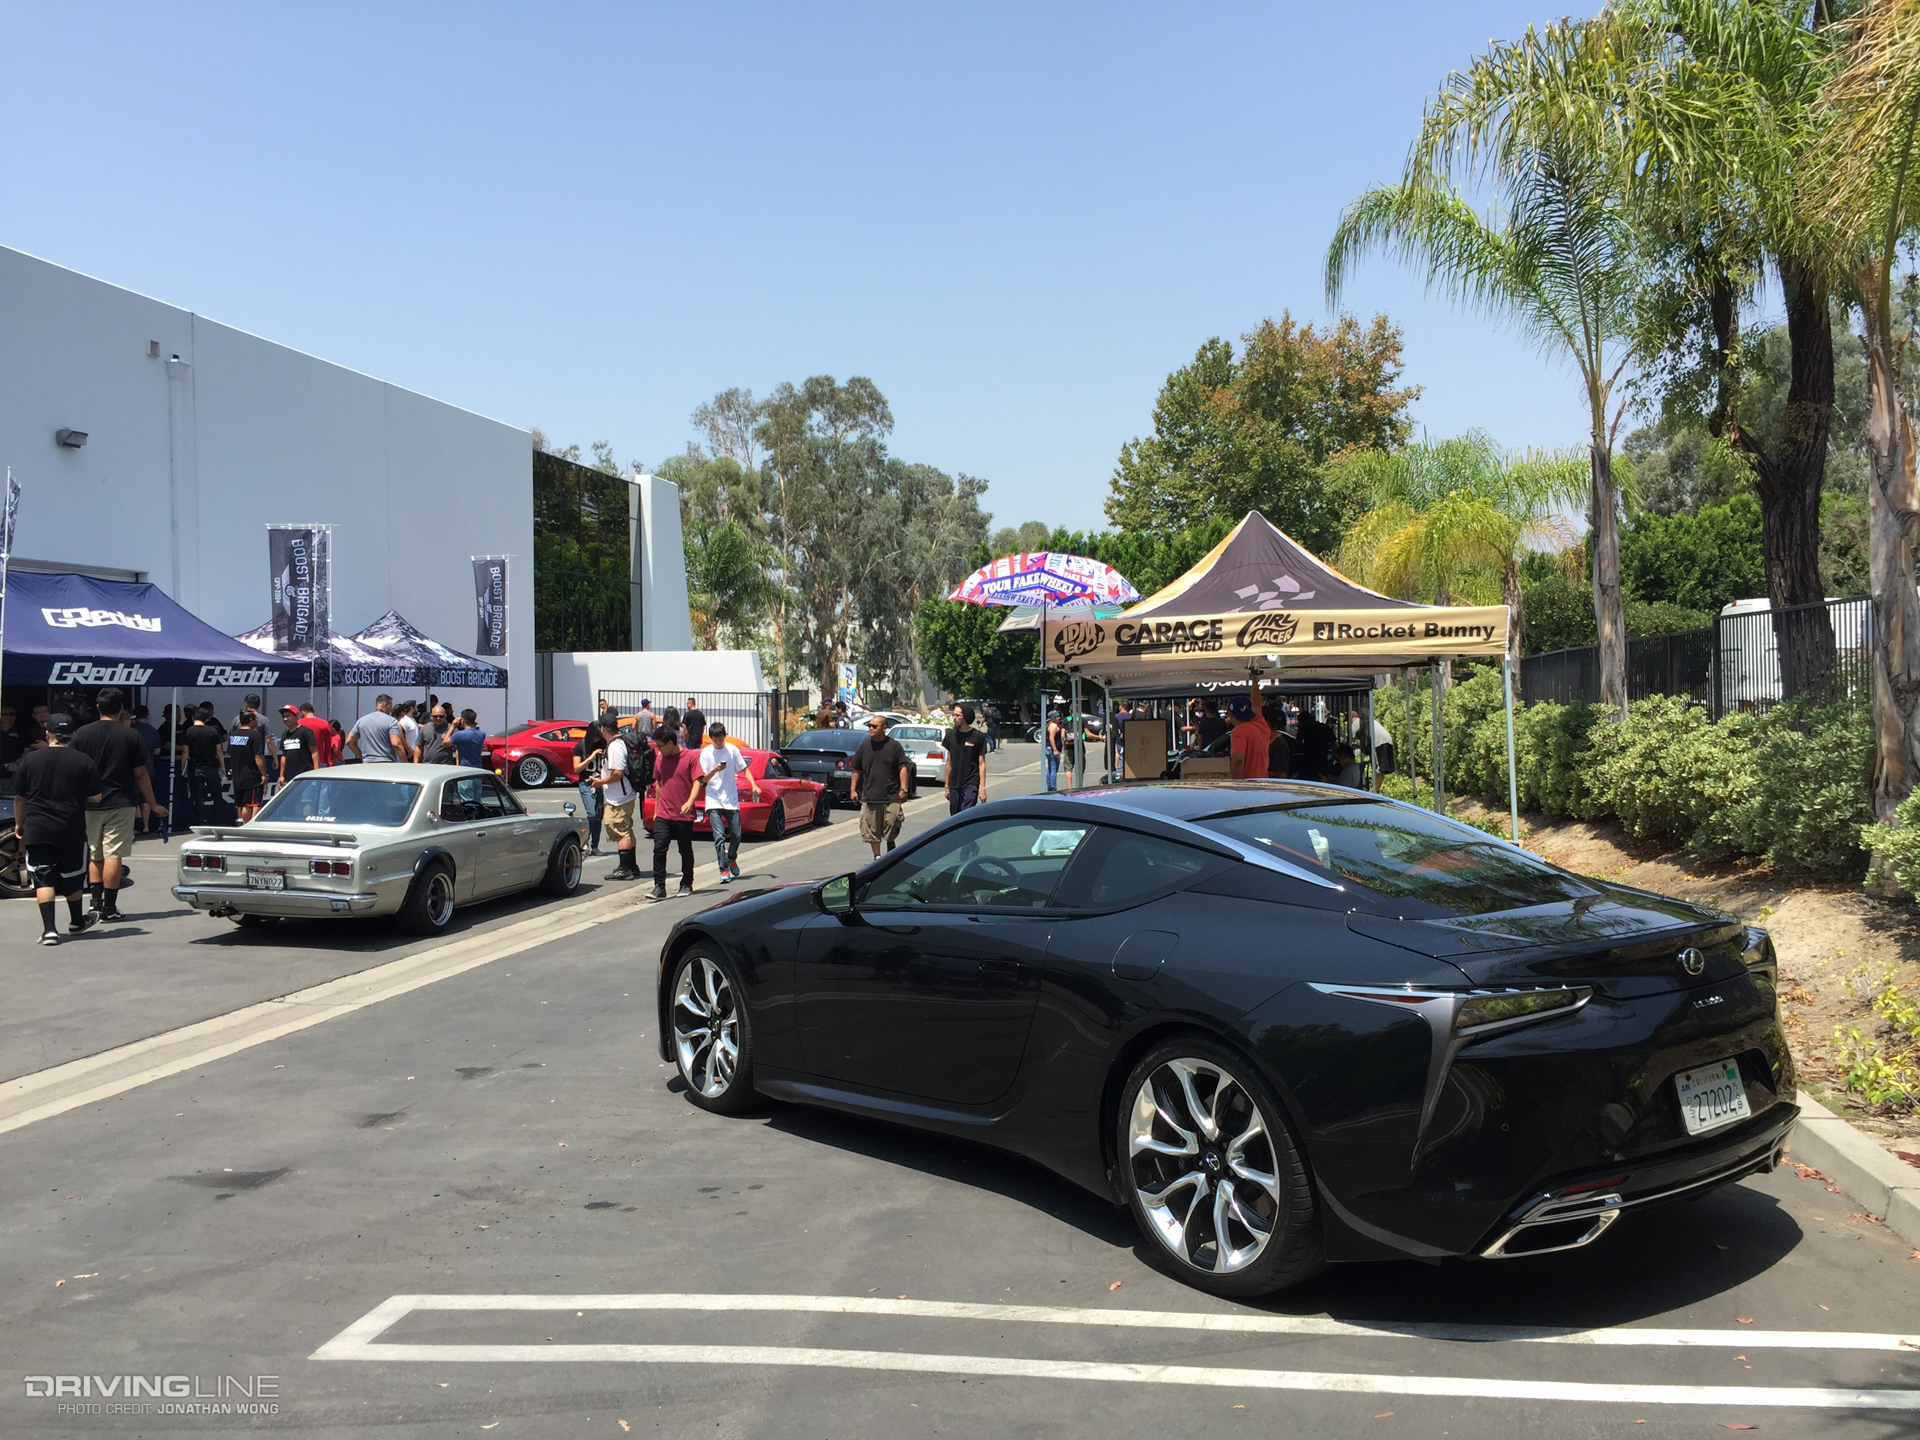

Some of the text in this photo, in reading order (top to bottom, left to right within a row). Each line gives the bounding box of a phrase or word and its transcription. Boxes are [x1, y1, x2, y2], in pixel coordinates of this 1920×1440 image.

[291, 538, 310, 642] BOOST BRIGADE
[982, 578, 1011, 594] YOUR
[1012, 571, 1040, 588] FAKE
[490, 566, 503, 649] BOOST BRIGADE
[41, 607, 161, 632] GReddy
[1236, 613, 1296, 647] GIRL
[1114, 619, 1223, 644] GARAGE
[1252, 627, 1294, 643] RACER
[1337, 622, 1495, 641] Rocket Bunny
[1174, 640, 1223, 654] TUNED
[48, 662, 153, 685] GReddy
[197, 665, 279, 686] GReddy
[345, 668, 416, 684] BOOST BRIGADE
[440, 670, 498, 686] BOOST BRIGADE
[1692, 1070, 1726, 1087] CALIFORNIA
[1694, 1084, 1737, 1122] 27202
